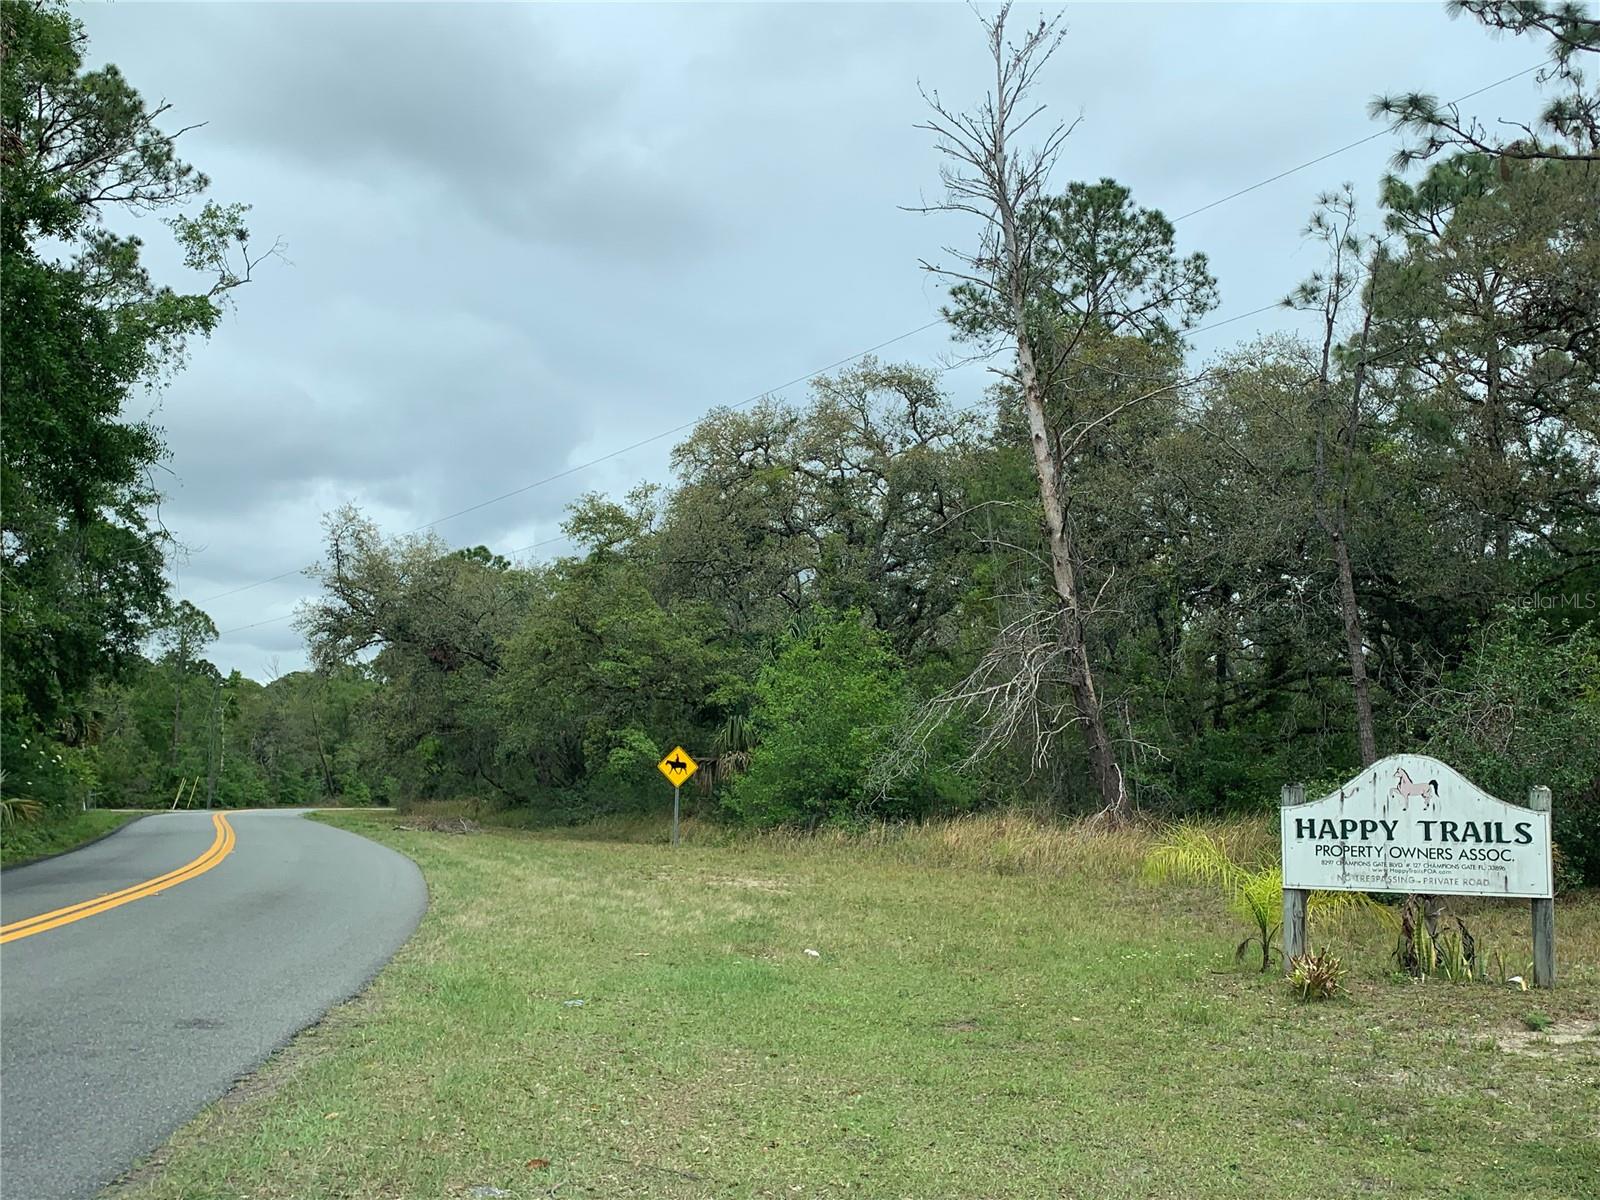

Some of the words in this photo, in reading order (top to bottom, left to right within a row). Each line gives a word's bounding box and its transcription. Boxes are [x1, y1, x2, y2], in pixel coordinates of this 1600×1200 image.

[1295, 818, 1399, 841] HAPPY
[1416, 820, 1533, 844] TRAILS
[1315, 845, 1384, 858] PROPERTY
[1389, 846, 1453, 860] OWNERS
[1458, 848, 1515, 862] ASSOC.
[1372, 860, 1387, 868] GATE
[1423, 862, 1460, 870] CHAMPIONS
[1337, 874, 1351, 882] NO
[1355, 874, 1415, 885] TRESPASSING
[1423, 877, 1458, 886] PRIVATE
[1462, 878, 1490, 887] ROAD
